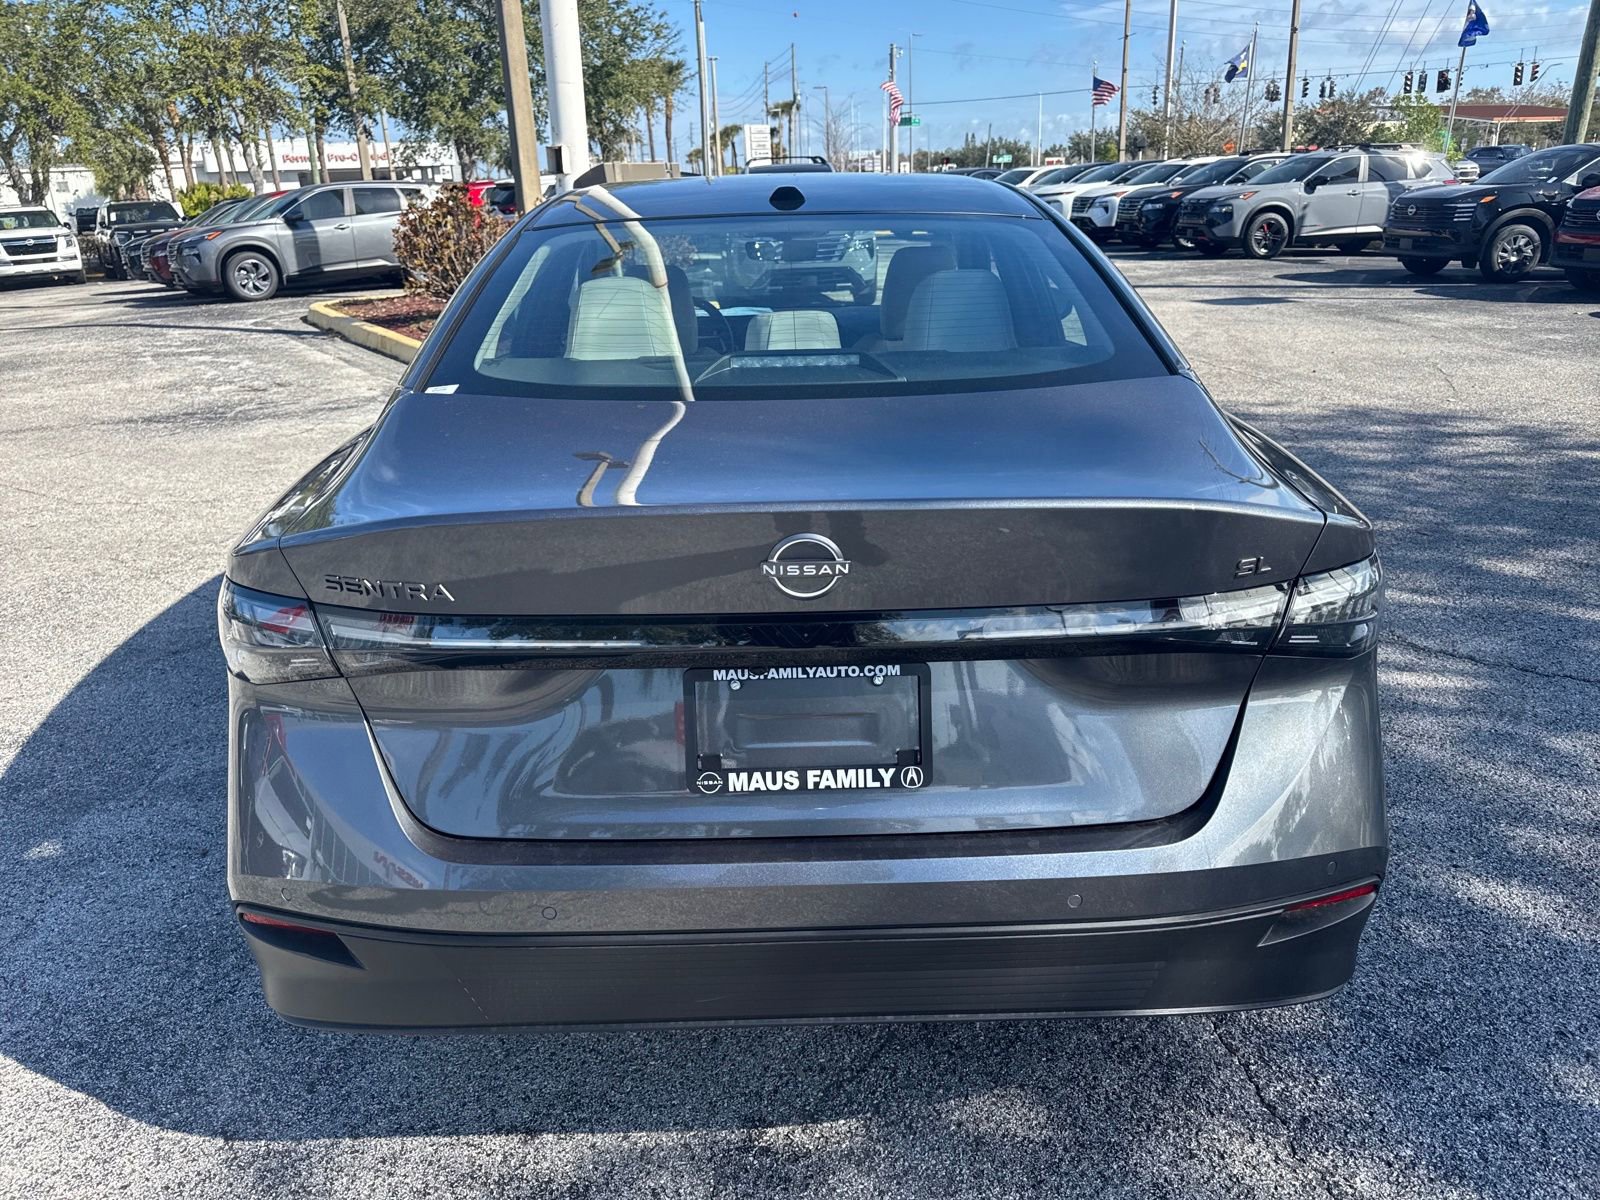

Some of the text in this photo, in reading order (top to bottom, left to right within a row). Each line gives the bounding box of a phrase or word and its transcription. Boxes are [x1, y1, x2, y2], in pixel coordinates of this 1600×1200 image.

[762, 563, 849, 576] NISSAN
[1235, 556, 1272, 578] SL
[324, 574, 455, 602] SENTRA
[728, 767, 896, 792] MAUS FAMILY
